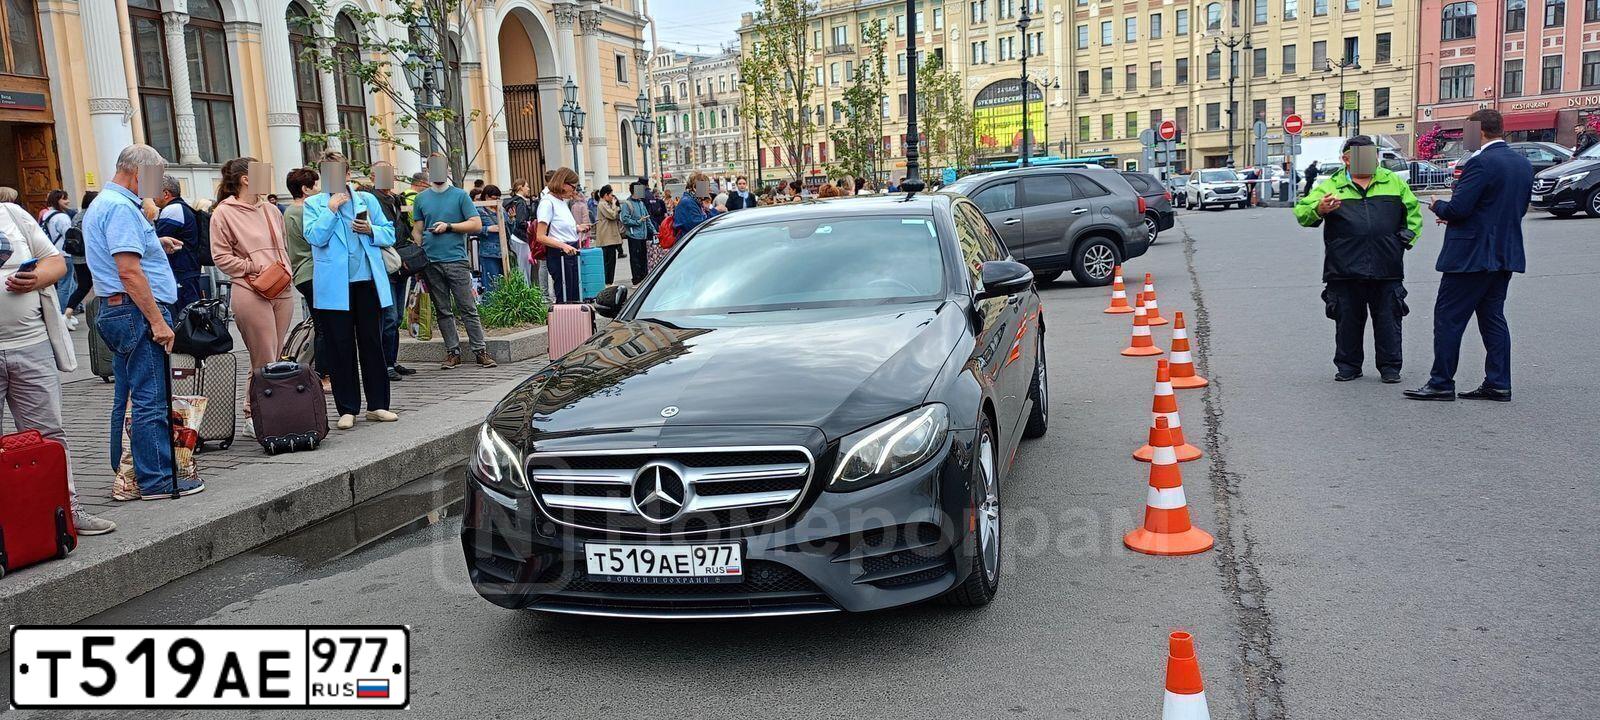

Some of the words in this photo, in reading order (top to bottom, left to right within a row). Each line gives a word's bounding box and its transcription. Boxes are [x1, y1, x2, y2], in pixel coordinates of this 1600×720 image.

[1511, 101, 1549, 110] RESTAURANT
[1568, 97, 1581, 107] DU
[594, 547, 690, 574] Т519АЕ
[694, 546, 733, 566] 977
